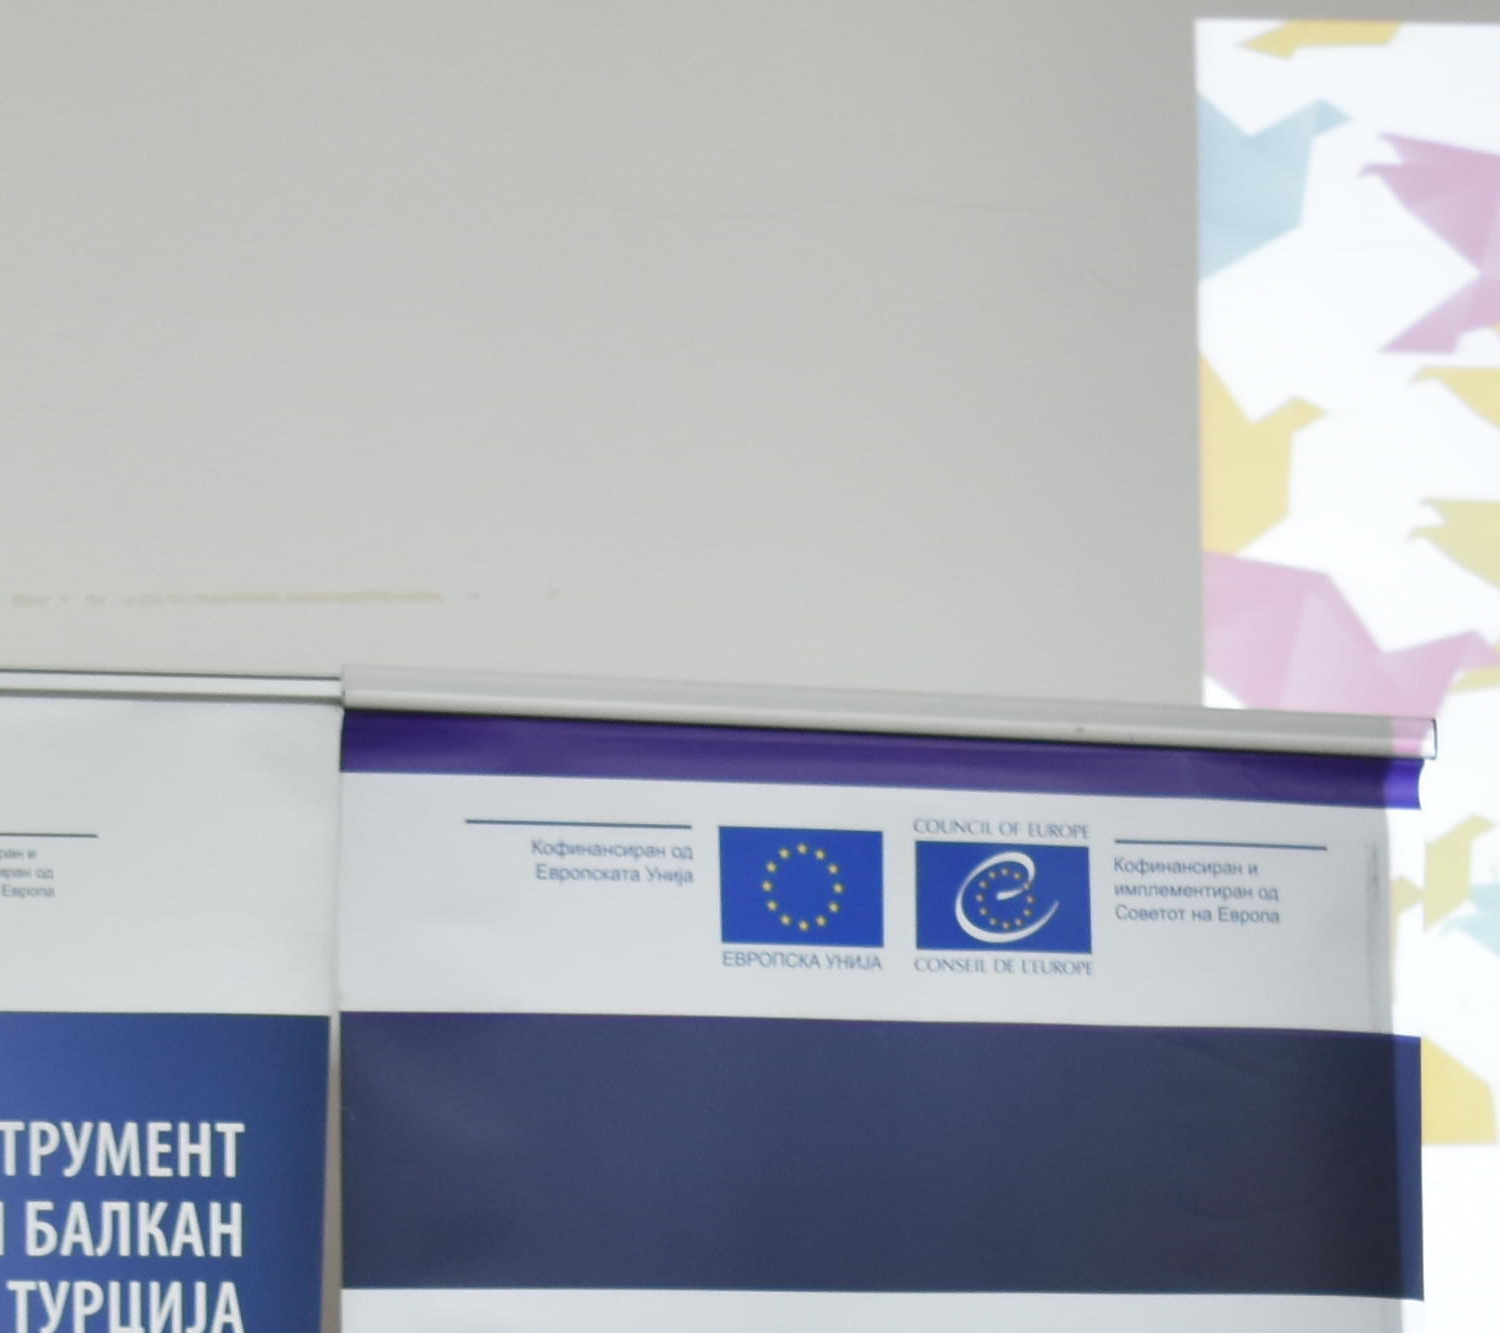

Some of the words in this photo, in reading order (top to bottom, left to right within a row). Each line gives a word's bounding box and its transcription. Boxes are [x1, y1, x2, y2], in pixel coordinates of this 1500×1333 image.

[913, 818, 993, 836] COUNCIL
[999, 820, 1021, 836] OF
[1028, 822, 1090, 840] EUROPE
[531, 838, 666, 861] Кофинансиран
[671, 844, 693, 861] од
[535, 863, 640, 883] Европската
[646, 867, 693, 886] Унија
[1114, 857, 1243, 876] Кофинансиран
[1248, 863, 1258, 875] и
[1114, 883, 1253, 902] имплементиран
[1258, 886, 1279, 902] од
[1115, 904, 1186, 922] Советот
[1191, 909, 1212, 922] на
[1218, 905, 1280, 925] Европа
[722, 951, 821, 969] ЕВРОПСКА
[826, 954, 883, 971] УНИЈА
[914, 957, 987, 974] CONSEIL
[994, 959, 1015, 974] DE
[23, 1200, 244, 1259] БАЛКАН
